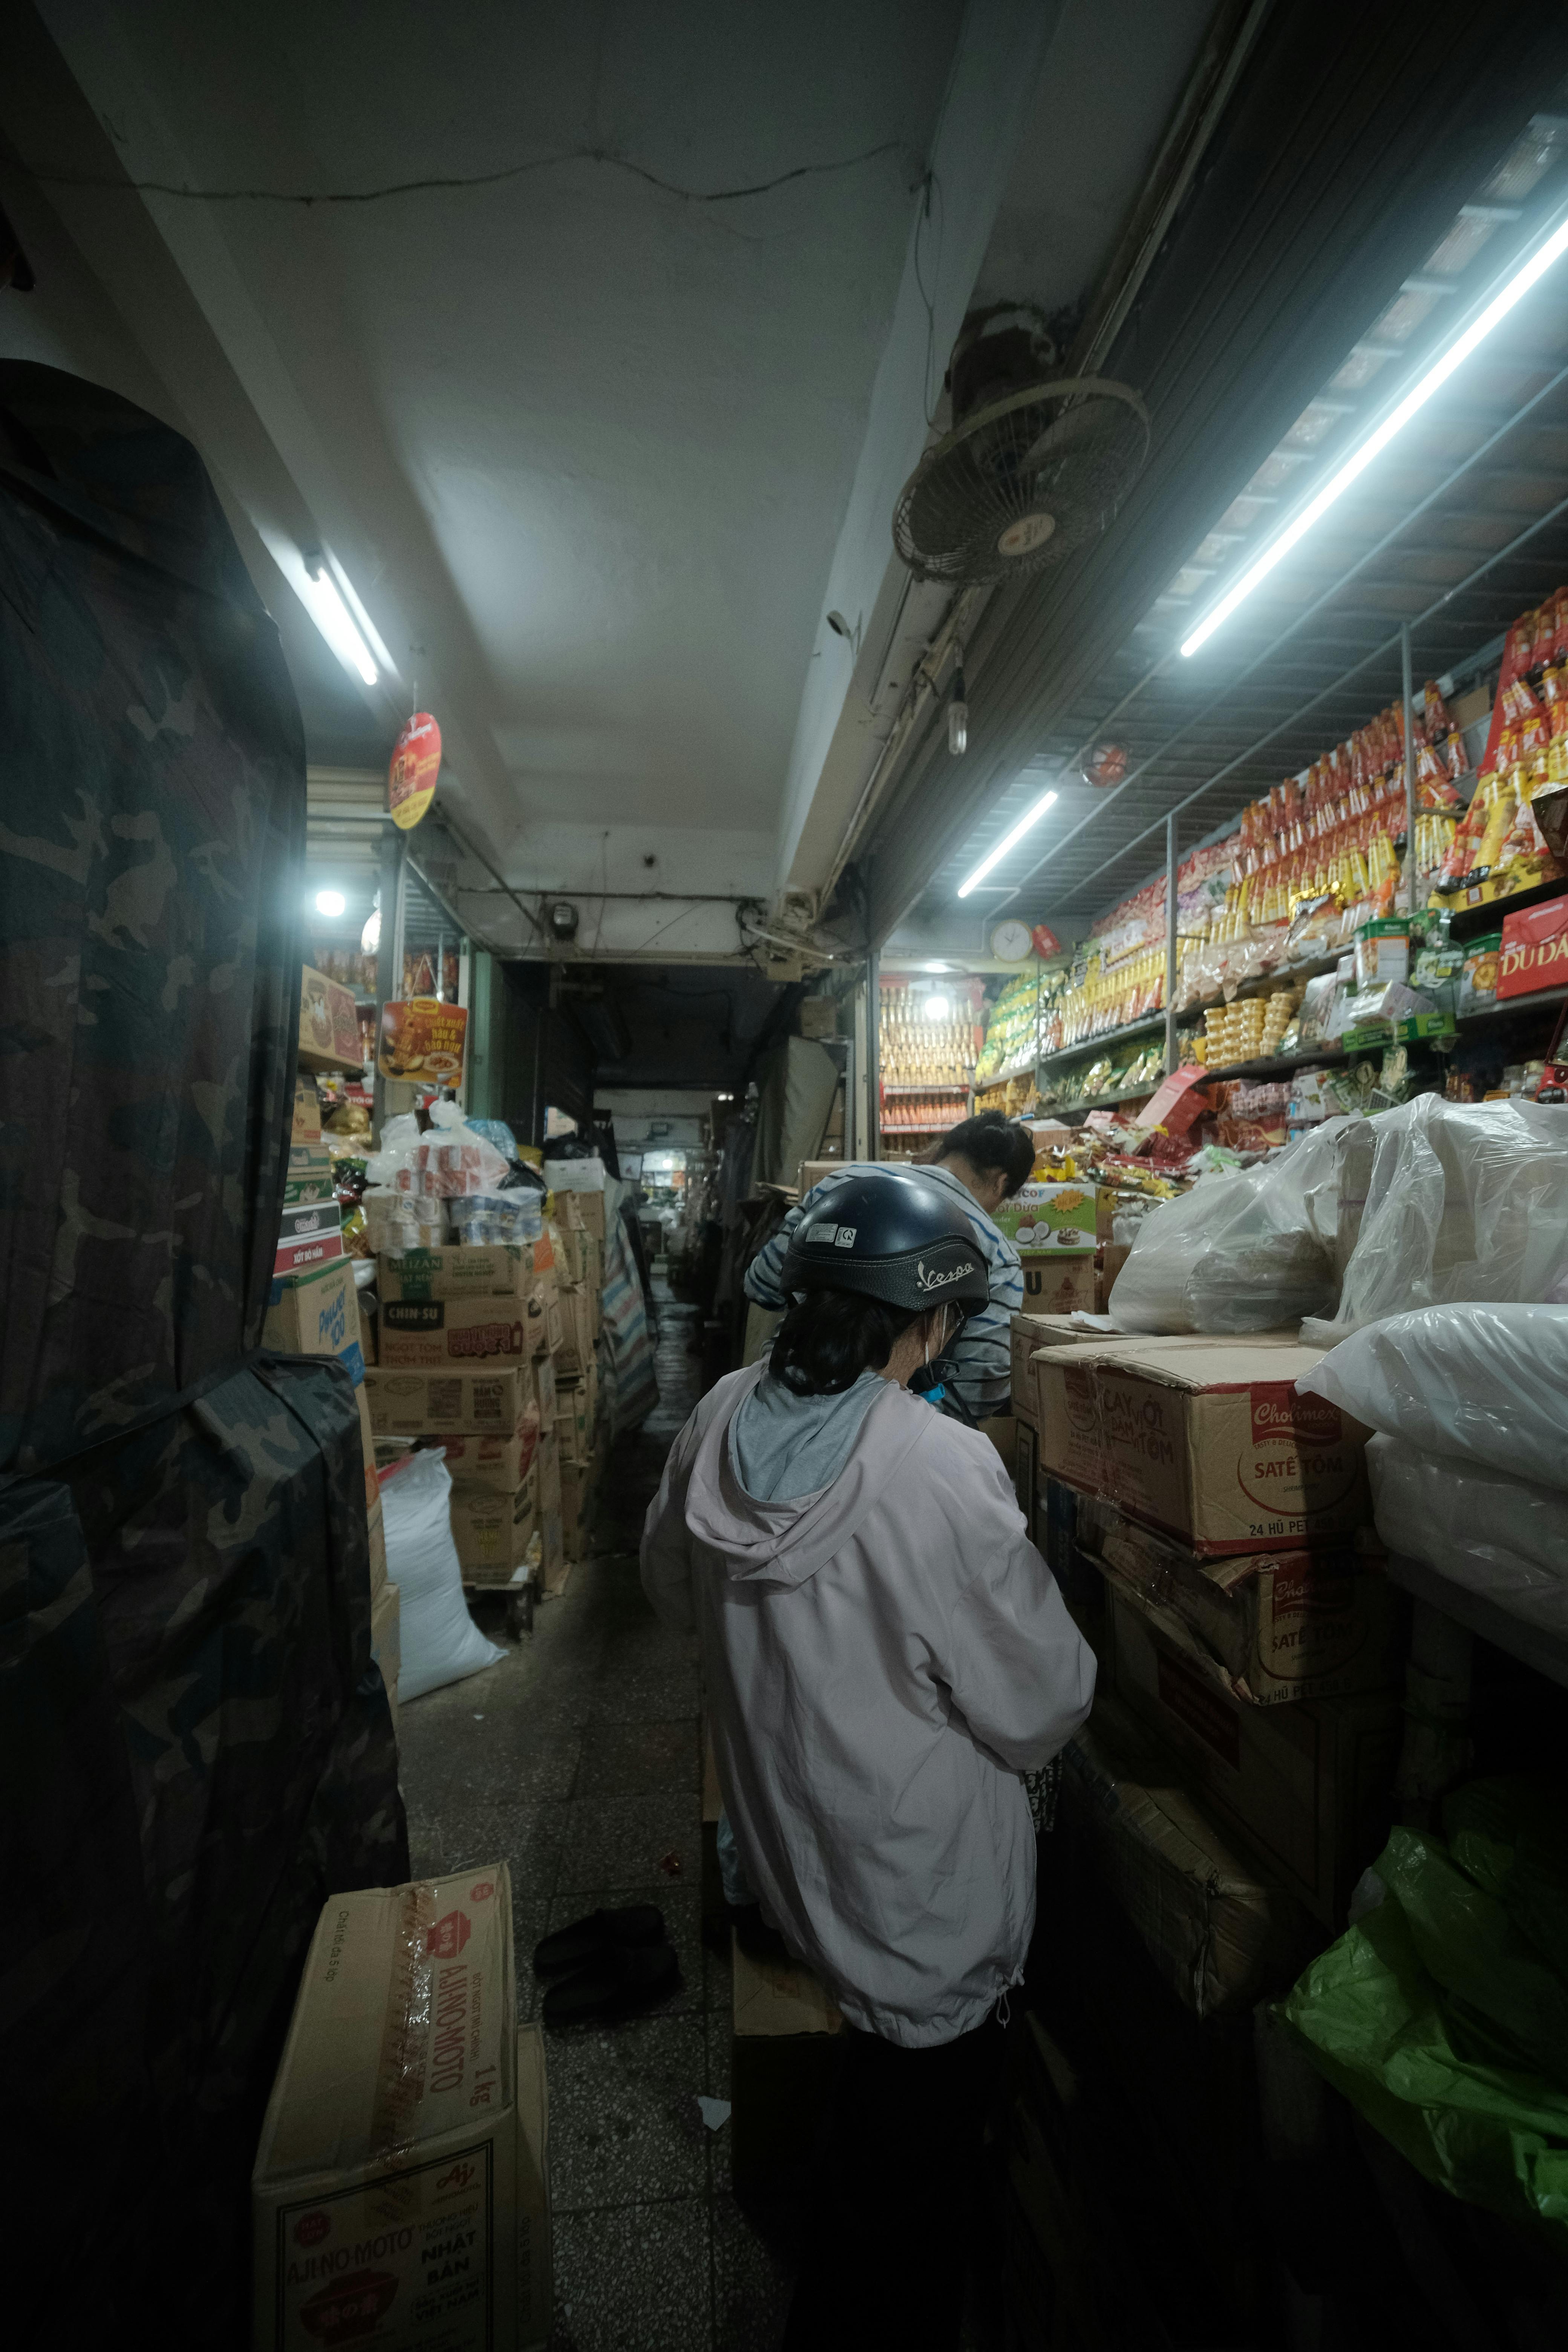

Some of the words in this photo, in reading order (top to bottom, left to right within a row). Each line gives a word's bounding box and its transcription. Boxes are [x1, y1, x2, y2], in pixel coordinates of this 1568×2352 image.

[1014, 1201, 1038, 1212] Dừa
[390, 1258, 441, 1269] MEIZAN
[916, 1261, 975, 1292] Vespa
[1104, 1389, 1133, 1417] CAY
[1254, 1403, 1339, 1425] Cholimex
[1254, 1440, 1270, 1450] TASTY
[1255, 1455, 1299, 1479] SATẾ
[1250, 1524, 1264, 1536] 24
[1269, 1519, 1284, 1535] HŨ
[1289, 1520, 1309, 1532] PET
[1294, 1683, 1314, 1696] PET
[335, 1911, 349, 1933] Chất
[334, 1934, 345, 1947] tối
[329, 1947, 340, 1958] đa
[326, 1969, 338, 1983] lớp
[471, 1991, 481, 2014] NGỌT
[475, 2066, 497, 2078] 1
[469, 2081, 495, 2107] kg
[421, 2231, 476, 2265] NHẬT
[520, 2239, 530, 2248] 5
[427, 2256, 470, 2285] BẢN
[447, 2289, 479, 2309] NAM
